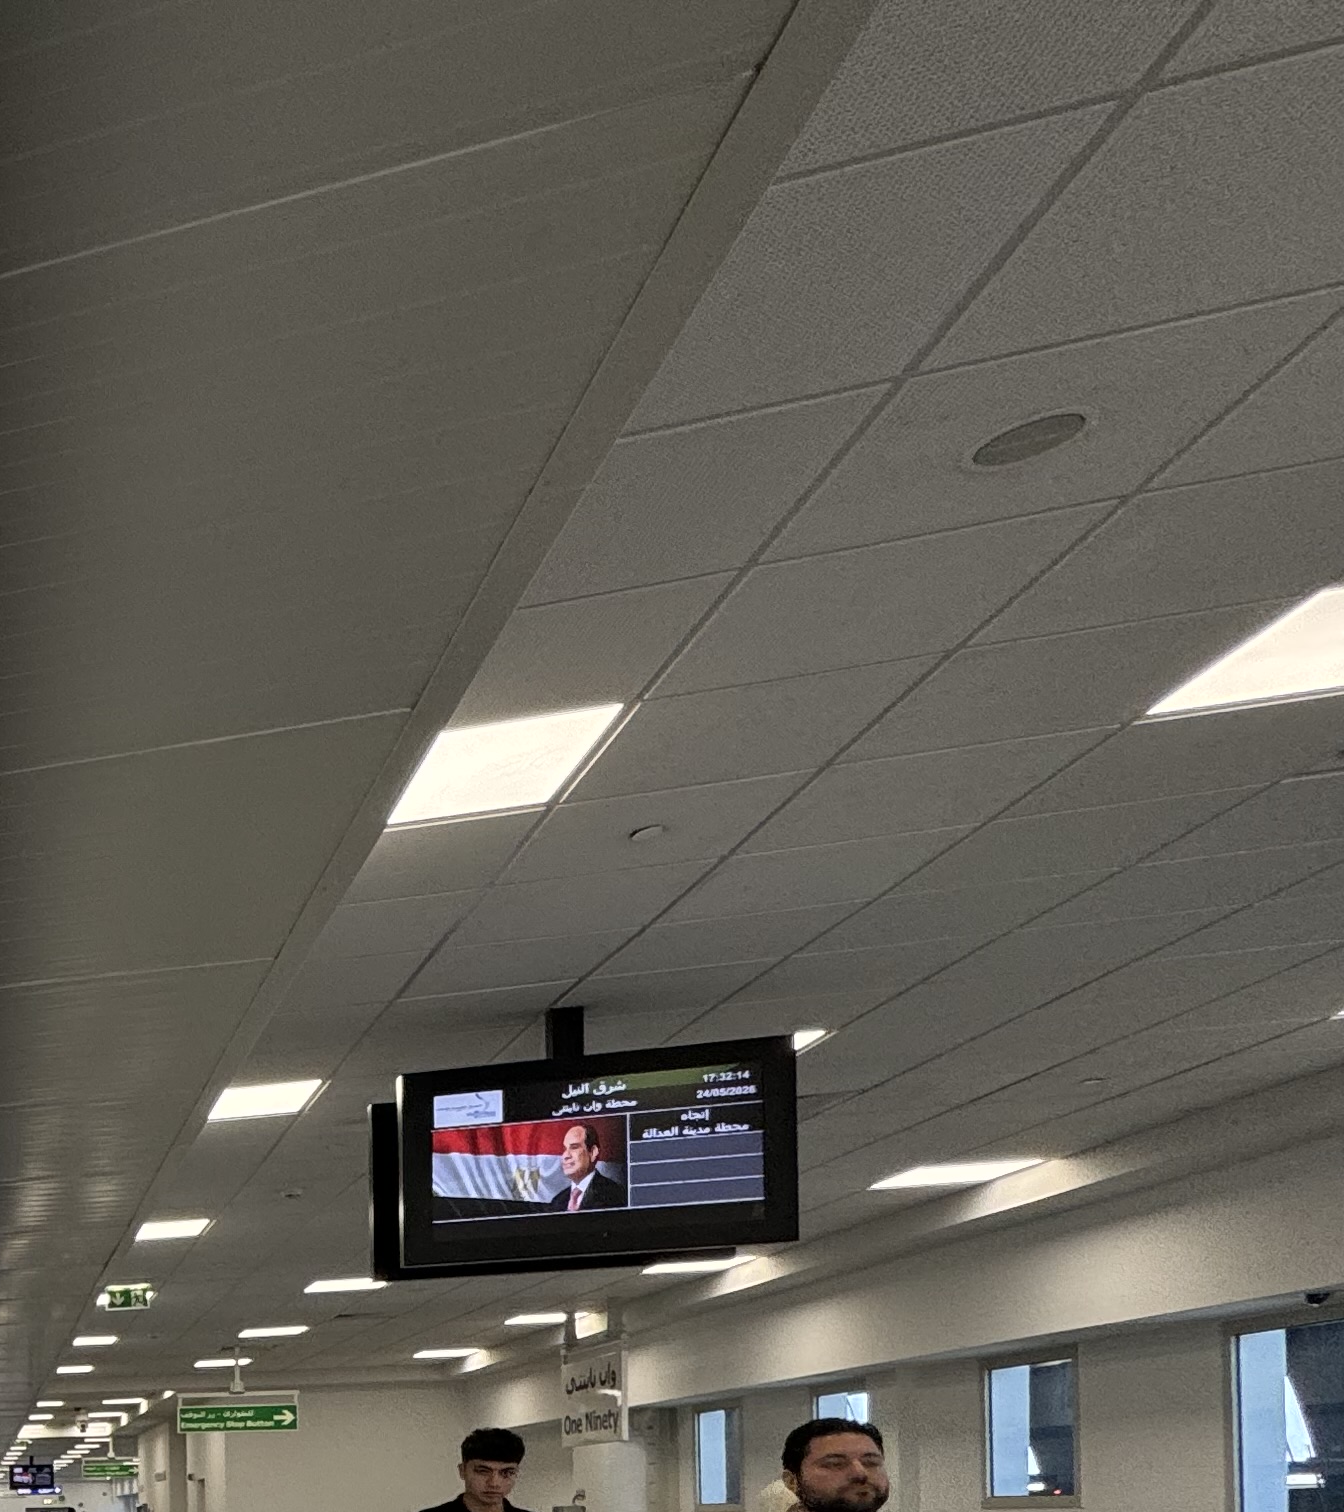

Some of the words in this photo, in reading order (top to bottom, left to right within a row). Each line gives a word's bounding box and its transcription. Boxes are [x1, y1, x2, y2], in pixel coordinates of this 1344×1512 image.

[561, 1082, 590, 1099] النيل
[592, 1080, 627, 1096] شرق
[605, 1099, 638, 1109] محطة
[642, 1126, 679, 1139] العدالة
[682, 1125, 711, 1136] مدينة
[714, 1122, 750, 1133] محطة
[564, 1415, 583, 1435] One
[585, 1409, 619, 1434] Ninety
